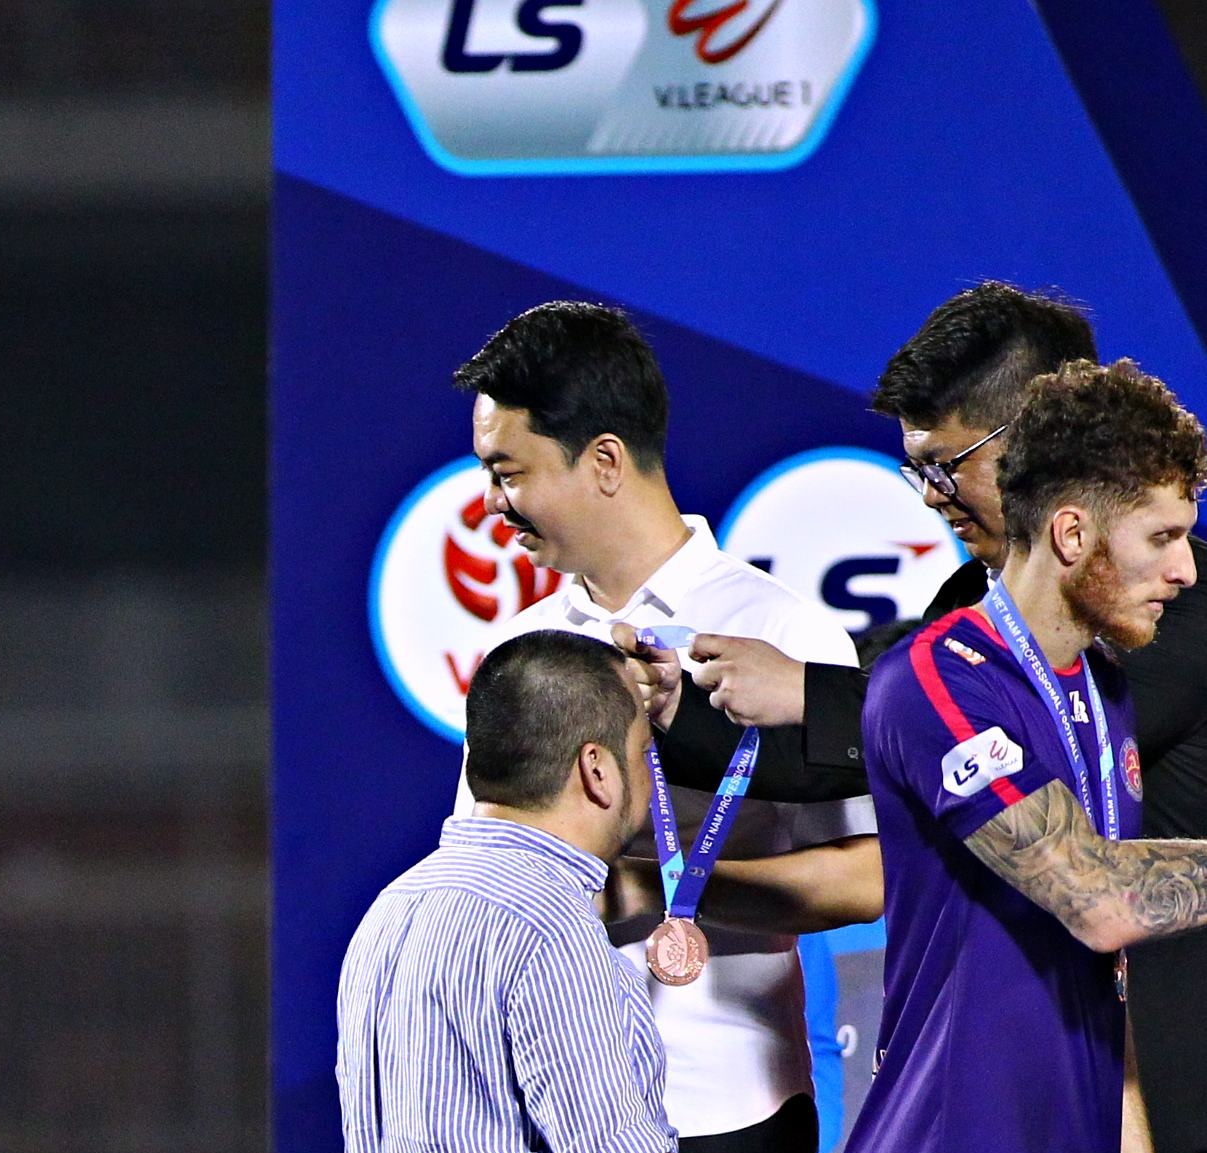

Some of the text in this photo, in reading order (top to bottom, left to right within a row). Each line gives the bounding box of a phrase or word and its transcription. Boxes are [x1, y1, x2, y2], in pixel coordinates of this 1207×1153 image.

[442, 0, 585, 73] LS
[992, 593, 1008, 614] VIET
[1002, 610, 1021, 637] NAM
[1016, 635, 1061, 710] PROFESSIONAL
[1059, 709, 1080, 763] FOOTBALL
[650, 752, 660, 765] LS
[664, 831, 676, 852] 2020
[699, 834, 714, 855] VIET
[709, 812, 724, 836] NAM
[718, 749, 754, 815] PROFESSIONAL
[953, 757, 979, 786] LS
